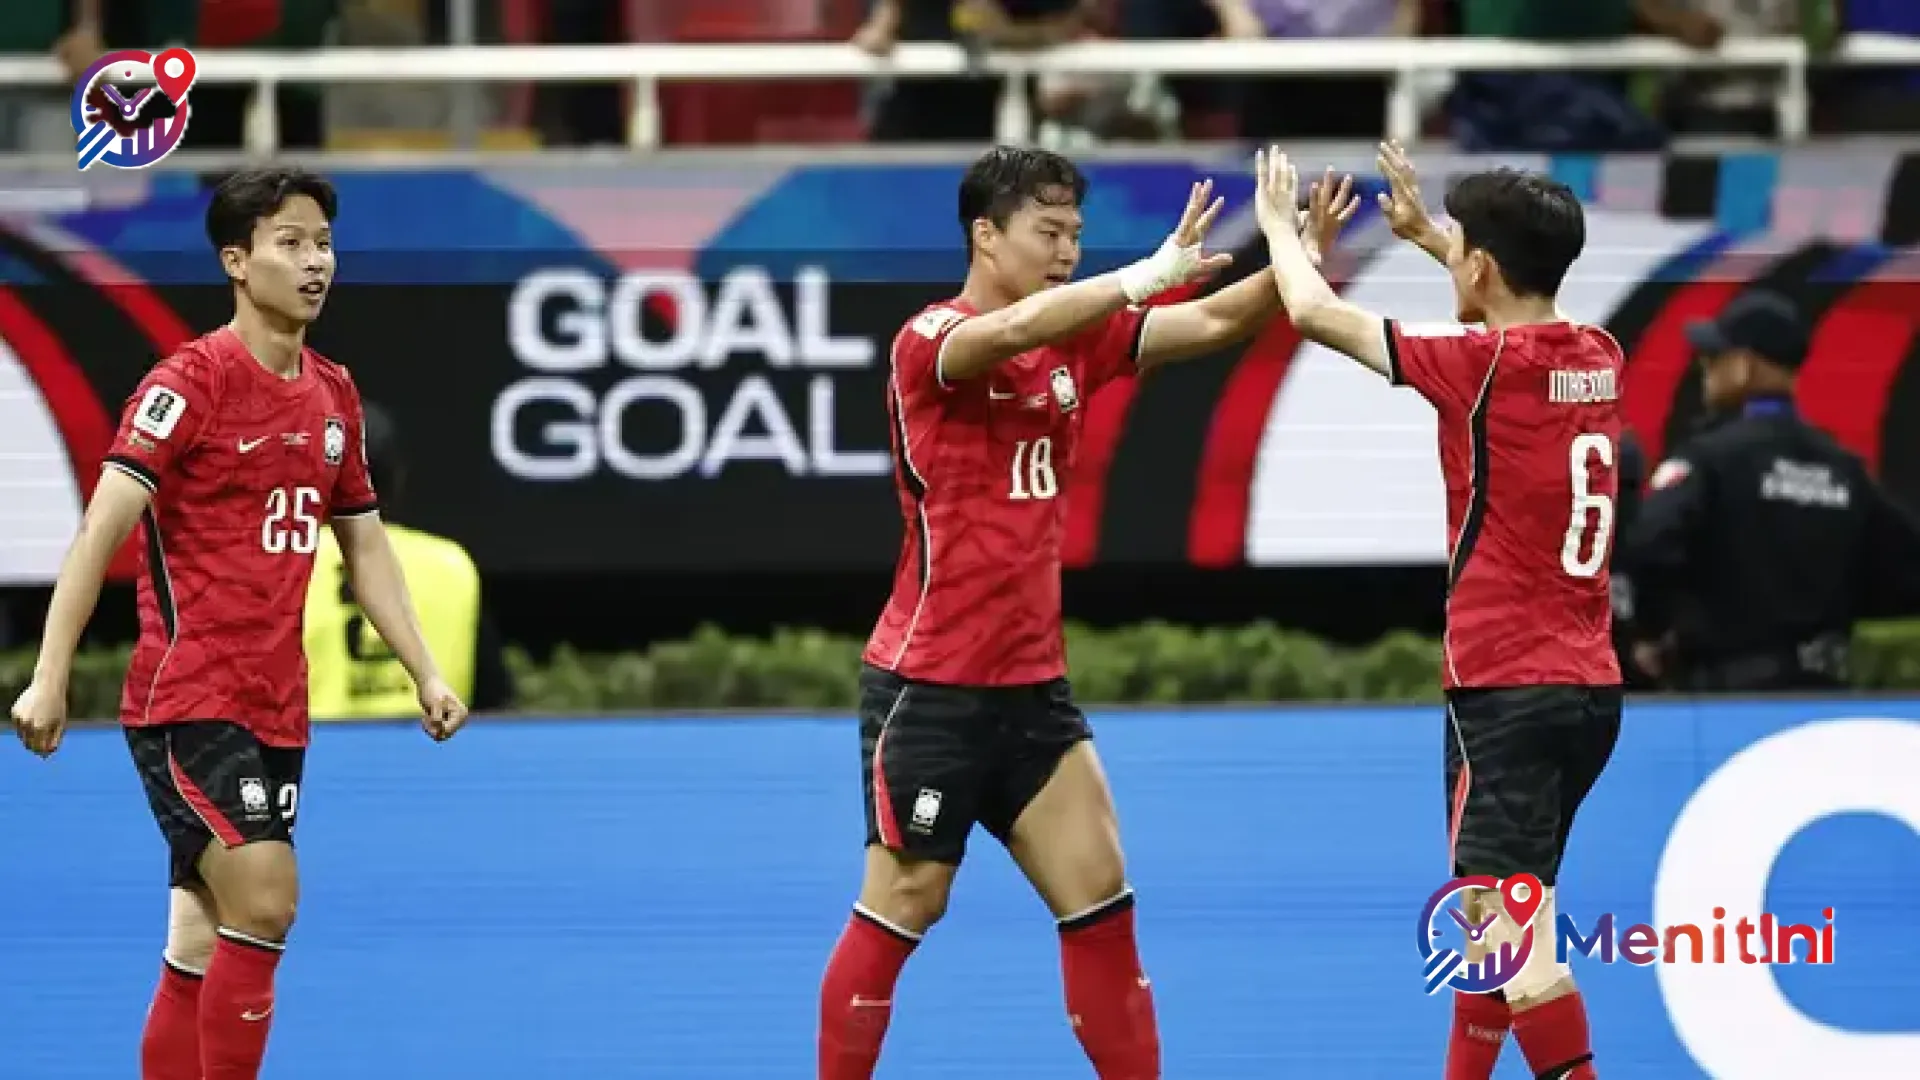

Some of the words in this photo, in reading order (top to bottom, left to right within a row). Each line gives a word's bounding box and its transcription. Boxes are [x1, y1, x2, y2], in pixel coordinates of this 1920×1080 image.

[507, 267, 876, 371] GOAL
[490, 376, 891, 480] GOAL
[1008, 436, 1059, 499] 18
[262, 486, 321, 554] 25
[1560, 433, 1613, 577] 6
